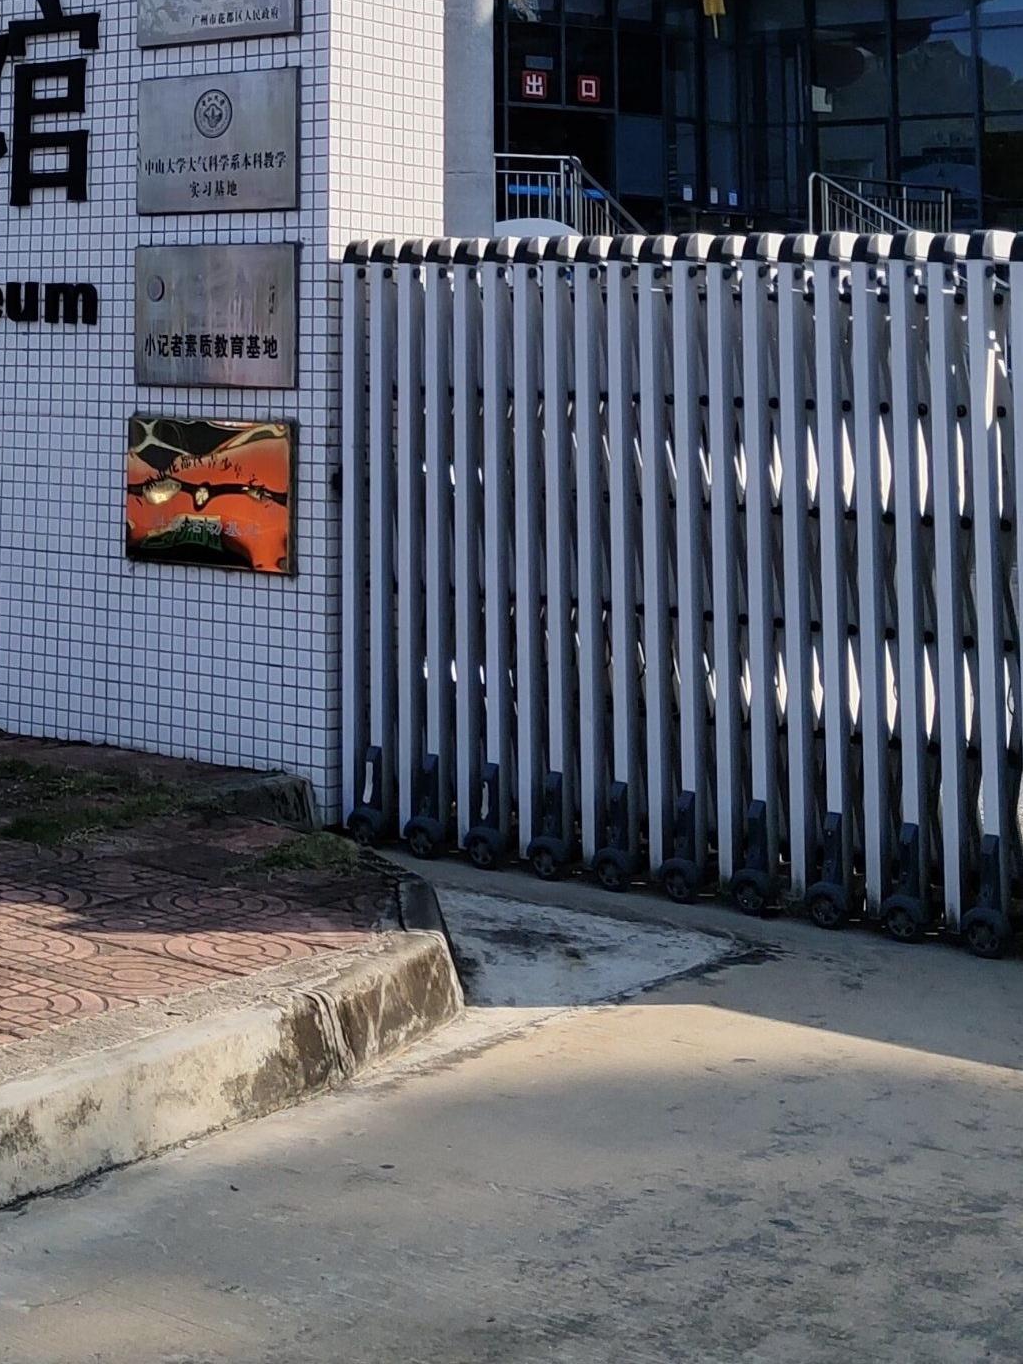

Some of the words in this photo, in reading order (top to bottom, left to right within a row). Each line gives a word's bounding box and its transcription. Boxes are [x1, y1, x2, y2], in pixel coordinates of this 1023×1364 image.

[191, 7, 279, 27] 广州市花都区人民政府
[144, 150, 287, 176] 中山大学大气科学系本科教学
[190, 180, 238, 198] 实习基地
[144, 333, 278, 359] 小记者素质教育基地
